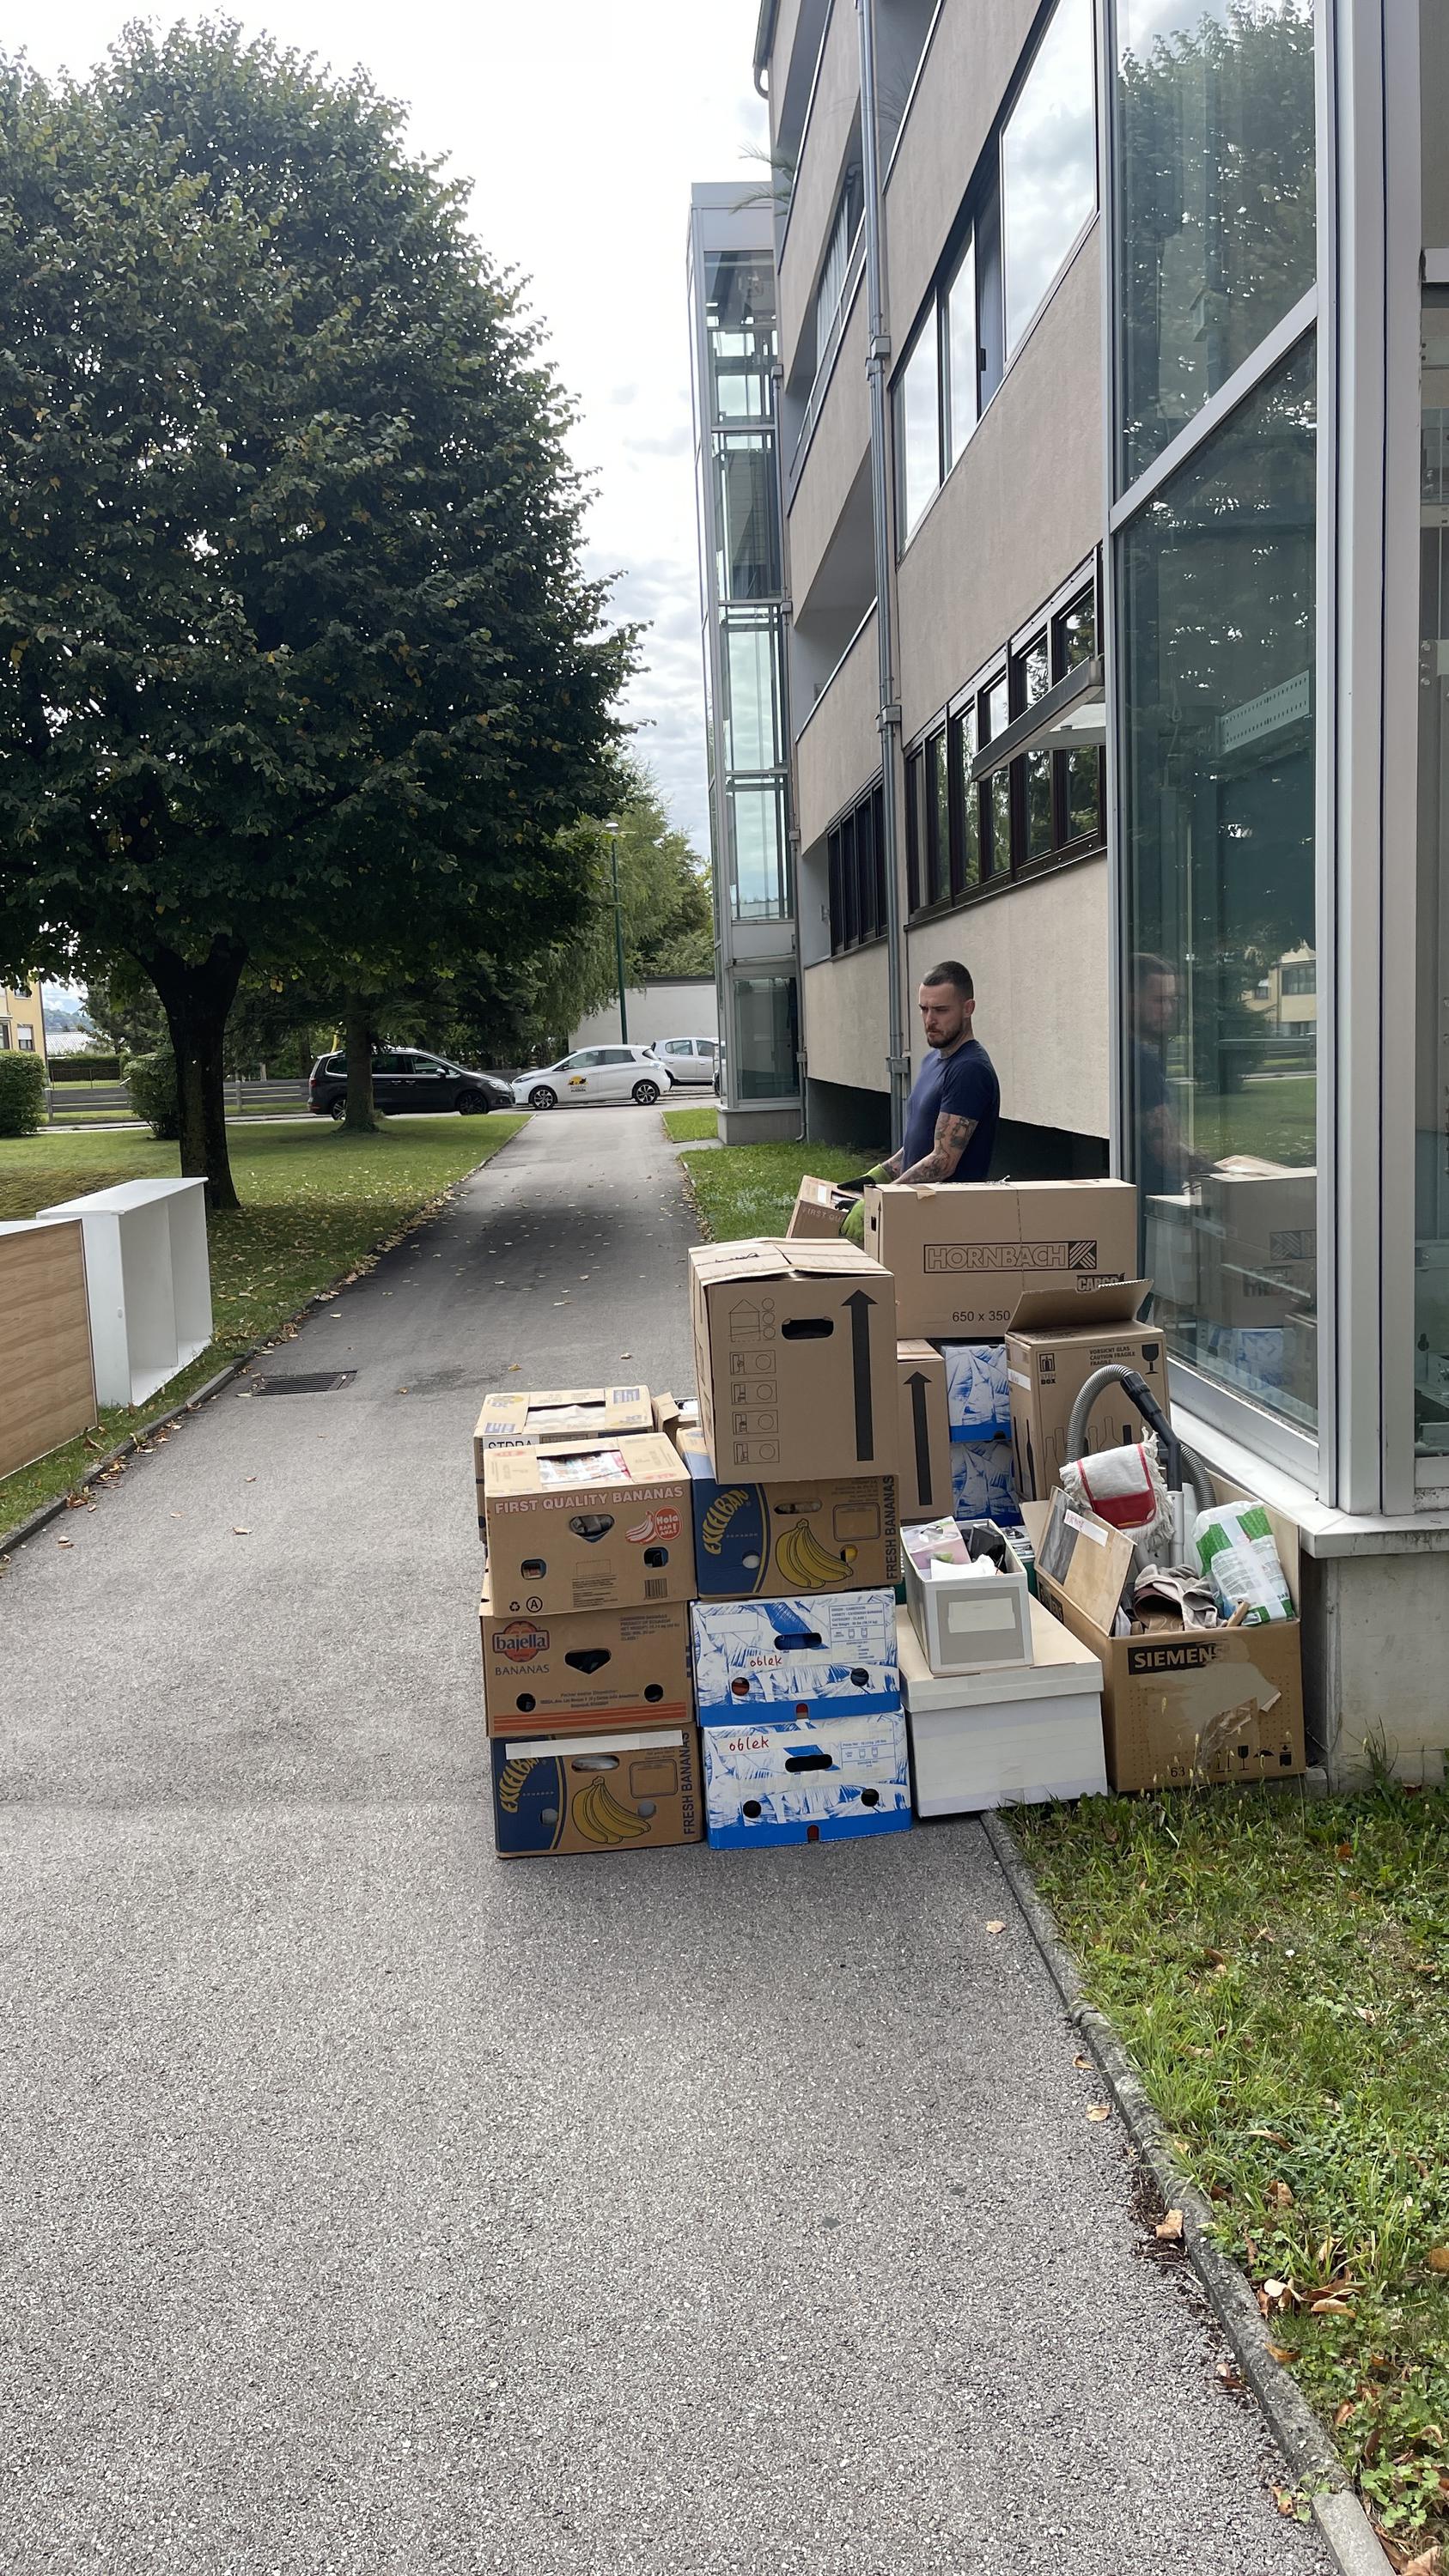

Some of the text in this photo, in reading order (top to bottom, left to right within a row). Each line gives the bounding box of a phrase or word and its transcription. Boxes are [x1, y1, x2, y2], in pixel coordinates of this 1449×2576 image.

[928, 1245, 1066, 1269] HORNBACH
[953, 1310, 1011, 1322] 650 x 350
[495, 1486, 684, 1515] FIRST QUALITY BANANAS
[656, 1514, 679, 1525] Hola
[883, 1476, 898, 1580] FRESH BANANAS
[496, 1633, 546, 1653] bajella
[495, 1664, 550, 1676] BANANAS
[750, 1655, 782, 1667] oblek
[728, 1735, 770, 1752] oblek
[683, 1795, 695, 1835] FRESH
